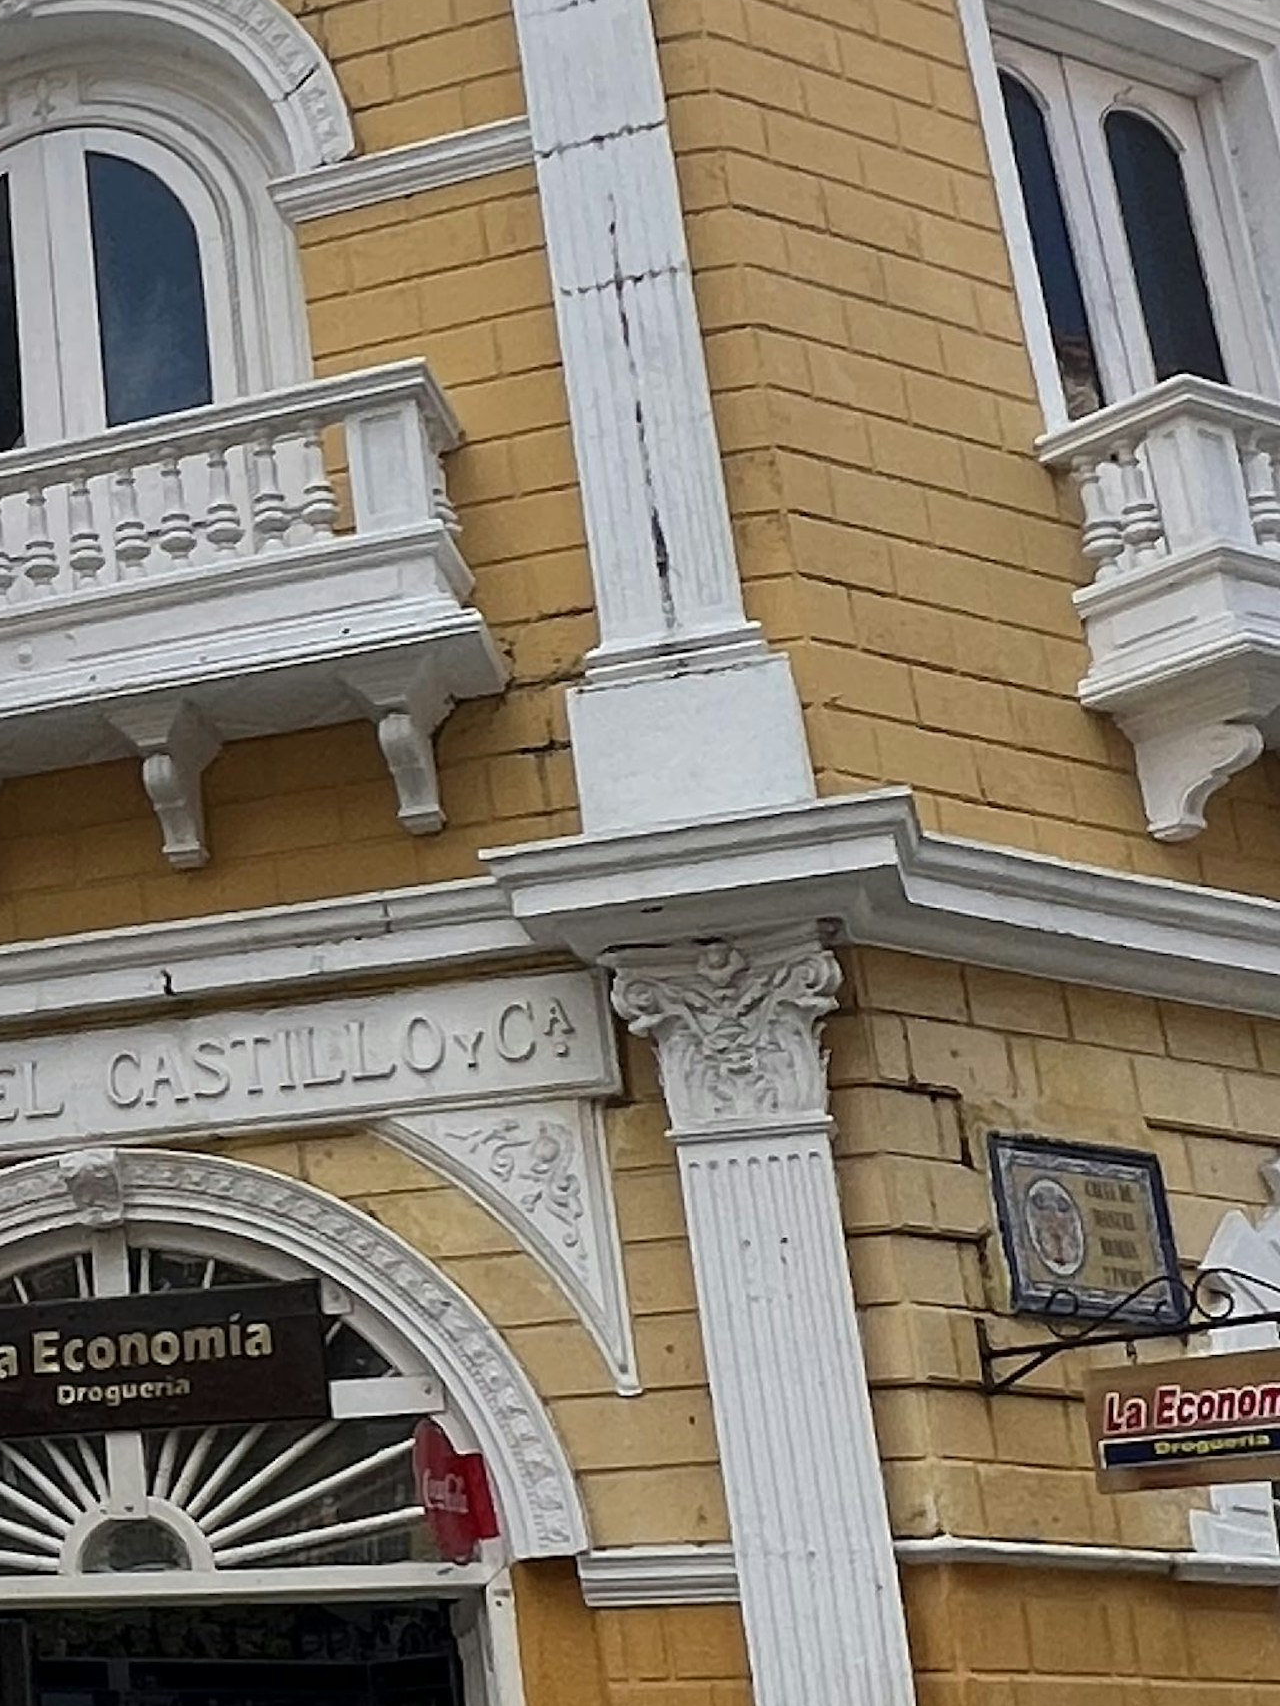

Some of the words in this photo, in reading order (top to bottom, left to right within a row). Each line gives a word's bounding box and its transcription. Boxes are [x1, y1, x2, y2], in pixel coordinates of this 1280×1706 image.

[106, 1016, 446, 1109] CASTILLO
[31, 1312, 273, 1375] Economía
[1103, 1391, 1149, 1434] La
